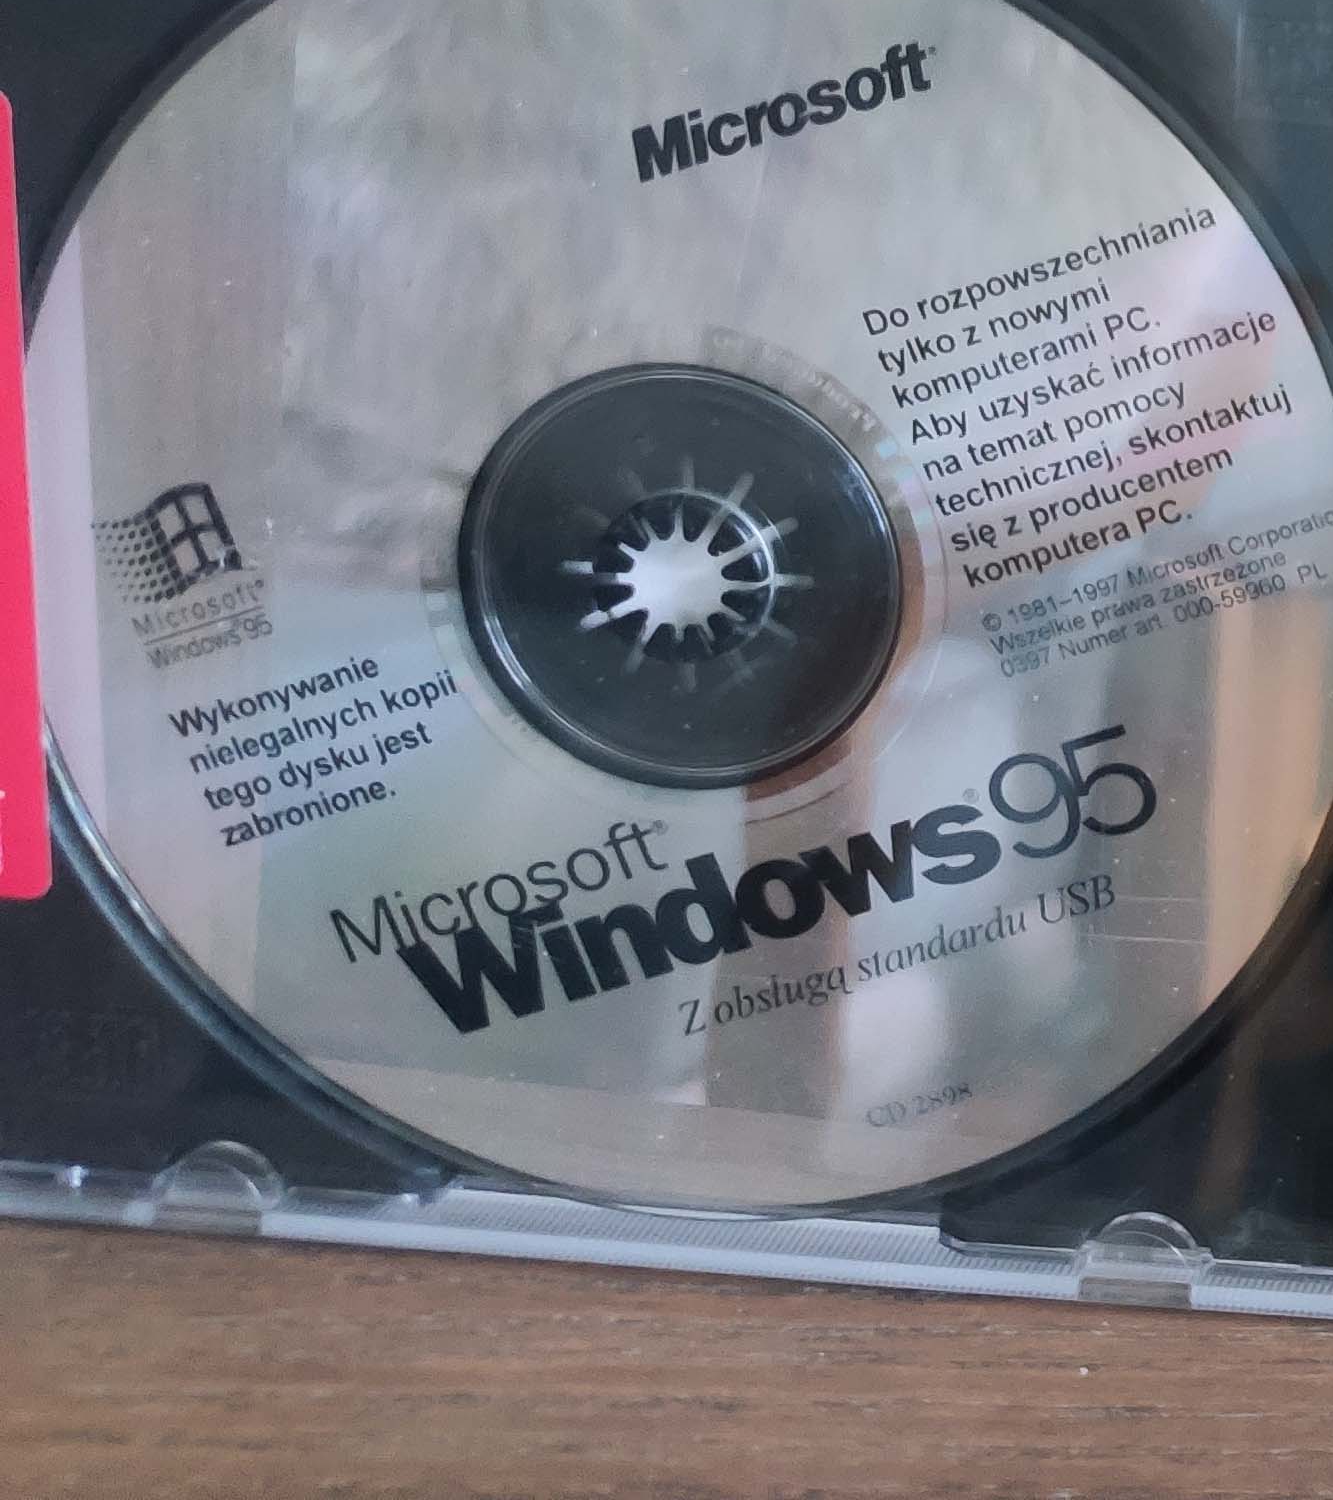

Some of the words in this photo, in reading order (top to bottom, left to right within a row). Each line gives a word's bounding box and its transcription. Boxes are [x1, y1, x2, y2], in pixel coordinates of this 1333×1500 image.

[632, 38, 936, 184] Microsoft
[862, 305, 911, 338] Do
[916, 204, 1217, 319] rozpowszechniania
[877, 332, 957, 375] tylko
[962, 321, 983, 349] z
[989, 277, 1112, 340] nowymi
[892, 325, 1098, 410] komputerami
[1105, 303, 1162, 342] PC.
[910, 407, 970, 446] Aby
[980, 361, 1106, 423] uzyskać
[1112, 308, 1278, 377] informacje
[922, 450, 963, 483] na
[970, 420, 1057, 464] temat
[1066, 377, 1187, 442] pomocy
[935, 435, 1124, 519] technicznej,
[1128, 382, 1294, 456] skontaktuj
[951, 520, 998, 555] się
[1006, 513, 1023, 537] z
[1029, 444, 1235, 533] producentem
[963, 517, 1133, 589] komputera
[1137, 496, 1194, 533] PC.
[131, 578, 264, 637] Microsoft
[990, 611, 1086, 655] Wszelkie
[1092, 597, 1156, 625] prawa
[1161, 550, 1287, 603] zastrzeżone
[1126, 541, 1225, 590] Microsoft
[147, 622, 242, 669] Windows
[1000, 645, 1053, 678] 0397
[1058, 627, 1128, 661] Numer
[1296, 563, 1328, 585] PL
[169, 657, 379, 737] Wykonywanie
[188, 698, 378, 775] nielegalnych
[380, 670, 458, 715] kopii
[204, 773, 272, 810] tego
[278, 743, 369, 790] dysku
[371, 722, 433, 766] jest
[219, 780, 397, 848] zabronione.
[329, 820, 672, 964] Microsoft
[398, 798, 1003, 1035] Windows
[988, 725, 1157, 860] 95
[679, 998, 711, 1038] Z
[713, 965, 851, 1027] obsługą
[856, 906, 1028, 986] standardu
[1035, 872, 1117, 926] USB
